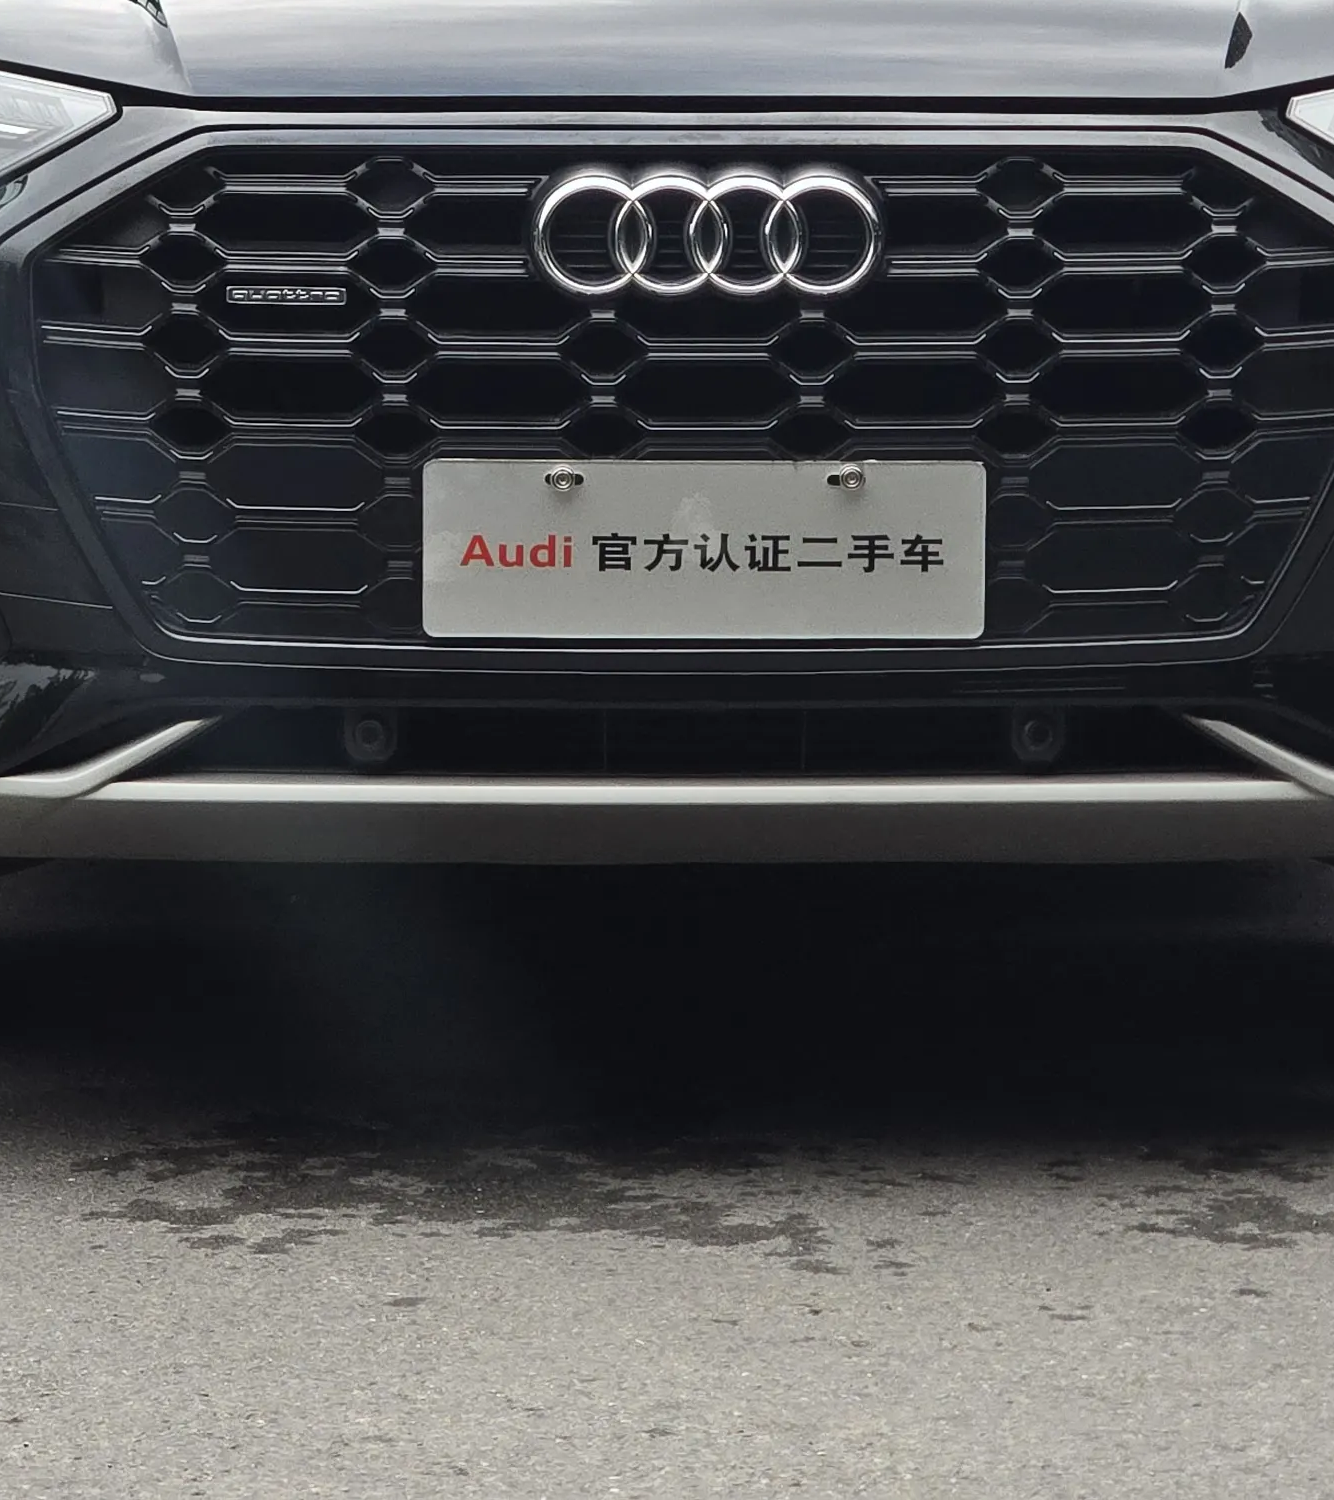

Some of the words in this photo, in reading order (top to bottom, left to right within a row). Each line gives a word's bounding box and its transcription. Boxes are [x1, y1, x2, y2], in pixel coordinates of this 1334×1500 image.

[232, 289, 340, 300] quattro
[460, 534, 573, 568] Audi
[591, 533, 945, 572] 官方认证二手车
